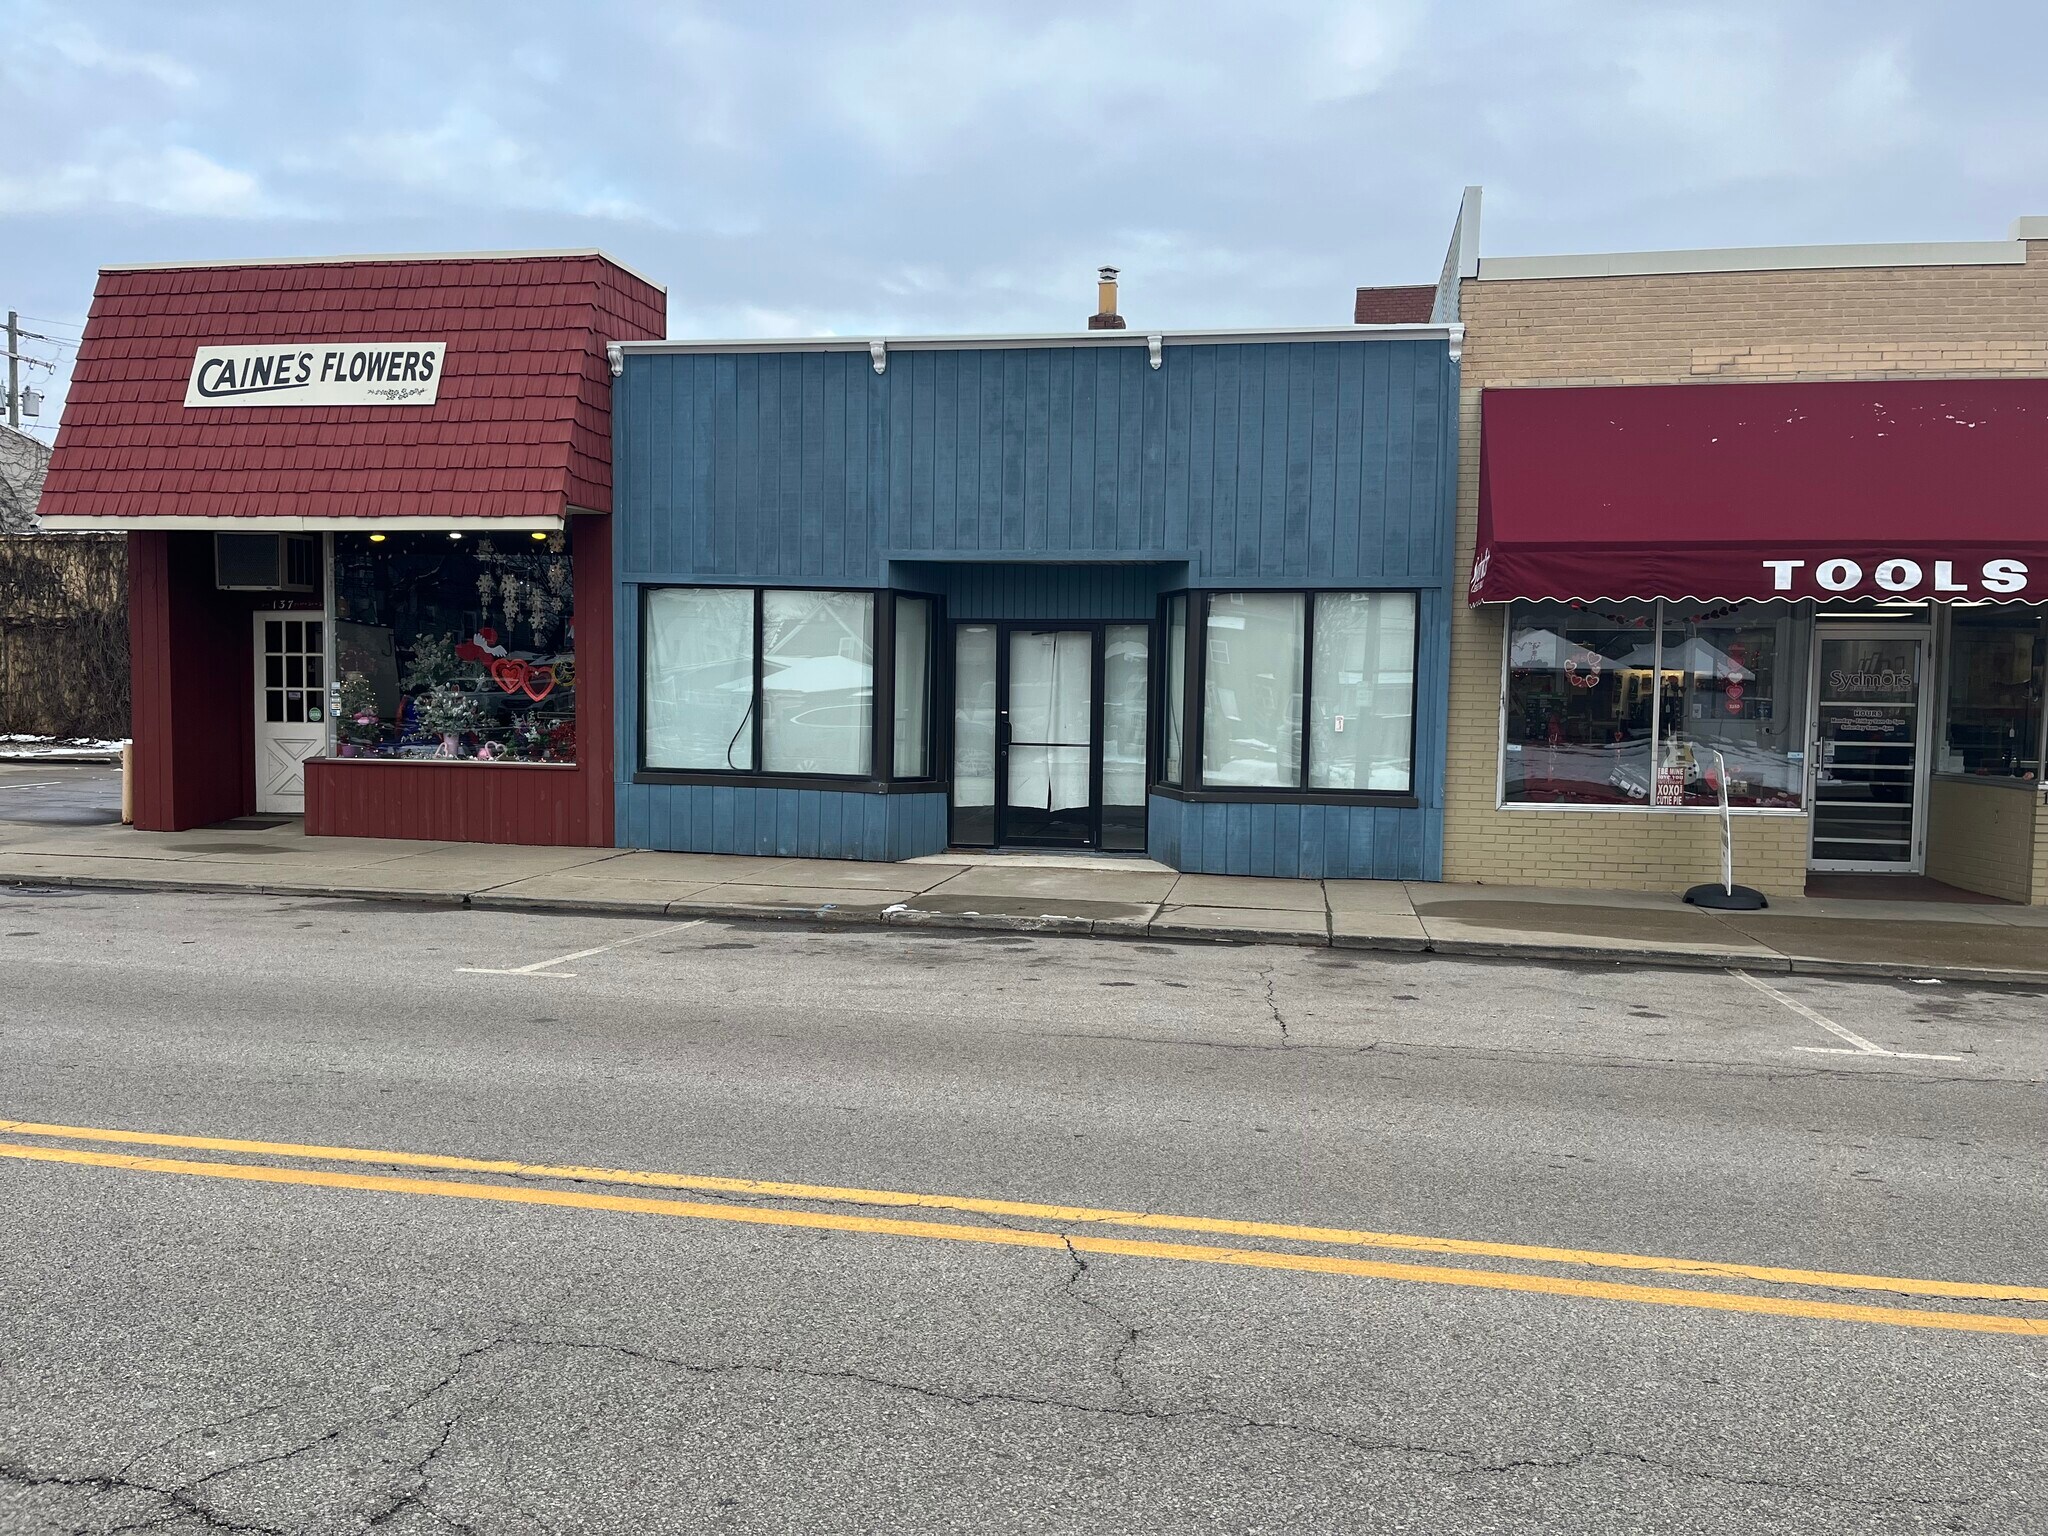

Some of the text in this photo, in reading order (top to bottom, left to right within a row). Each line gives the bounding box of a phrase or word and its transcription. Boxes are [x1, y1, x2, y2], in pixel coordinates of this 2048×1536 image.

[197, 350, 436, 397] CAINE'S FLOWERS
[1762, 558, 2029, 593] TOOLS
[273, 600, 294, 609] 137
[1830, 669, 1912, 691] Sydmor's
[1657, 785, 1679, 795] XOXO
[1656, 796, 1682, 806] CUTIE PIE
